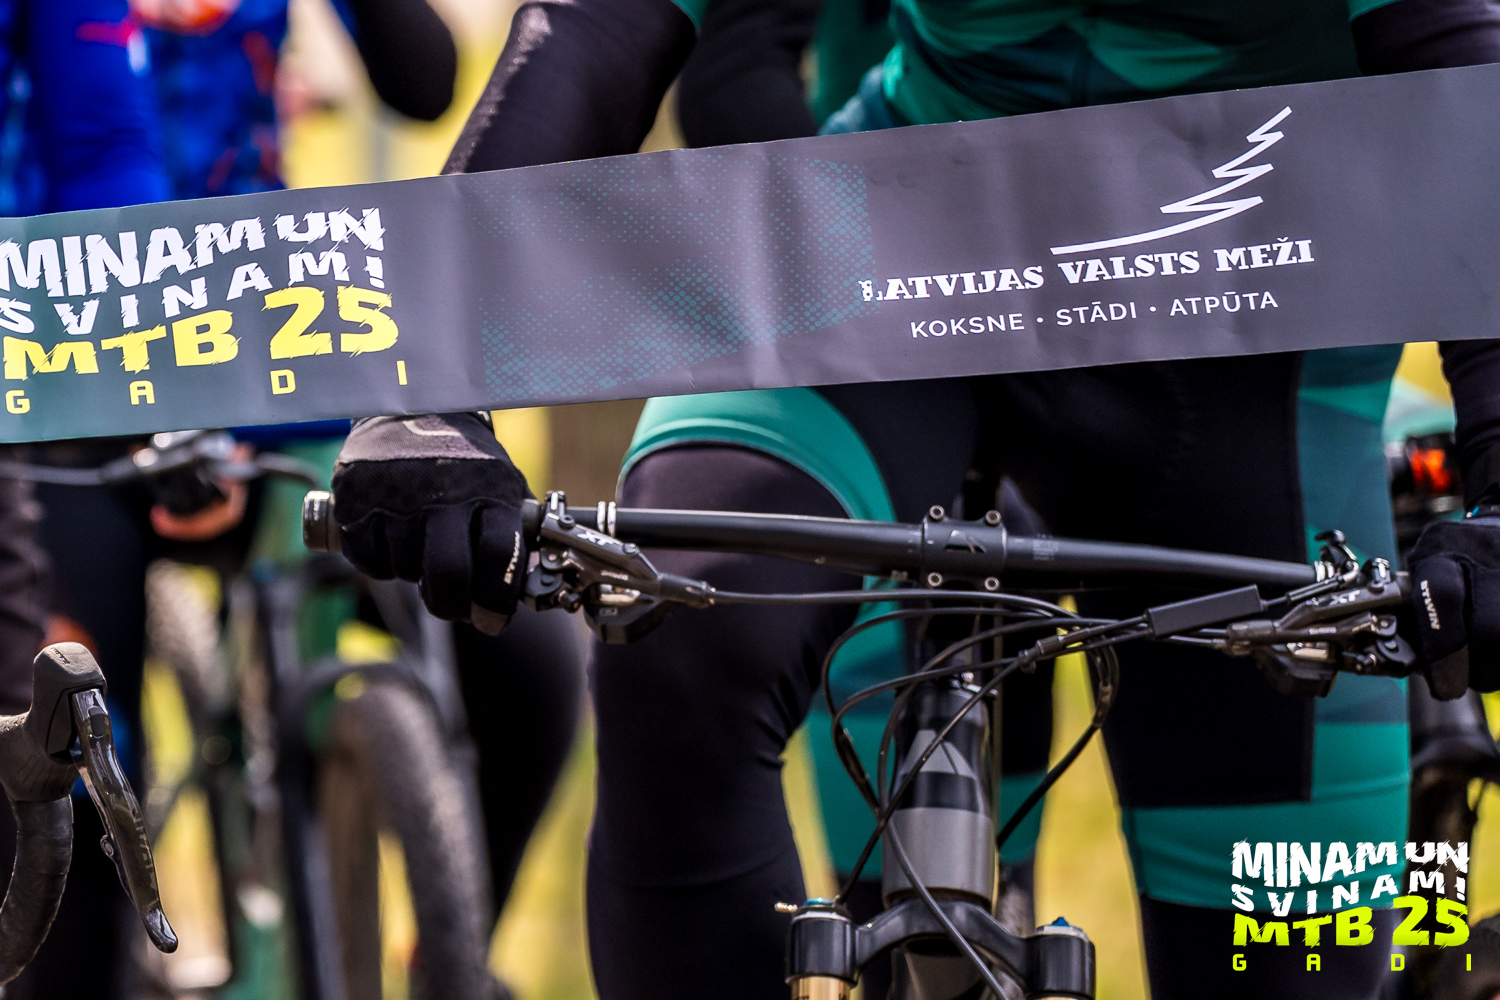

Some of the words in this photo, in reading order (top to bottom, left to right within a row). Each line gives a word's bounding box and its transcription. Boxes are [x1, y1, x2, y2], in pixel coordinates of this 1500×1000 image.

[271, 207, 386, 252] UN
[858, 264, 1046, 303] LATVIJAS
[1057, 249, 1201, 285] VALSTS
[1213, 237, 1316, 273] MEŽI
[2, 309, 240, 382] MTB
[261, 285, 400, 360] 25
[910, 312, 1026, 340] KOKSNE
[1055, 300, 1138, 327] STĀDI
[1168, 290, 1279, 318] ATPŪTA
